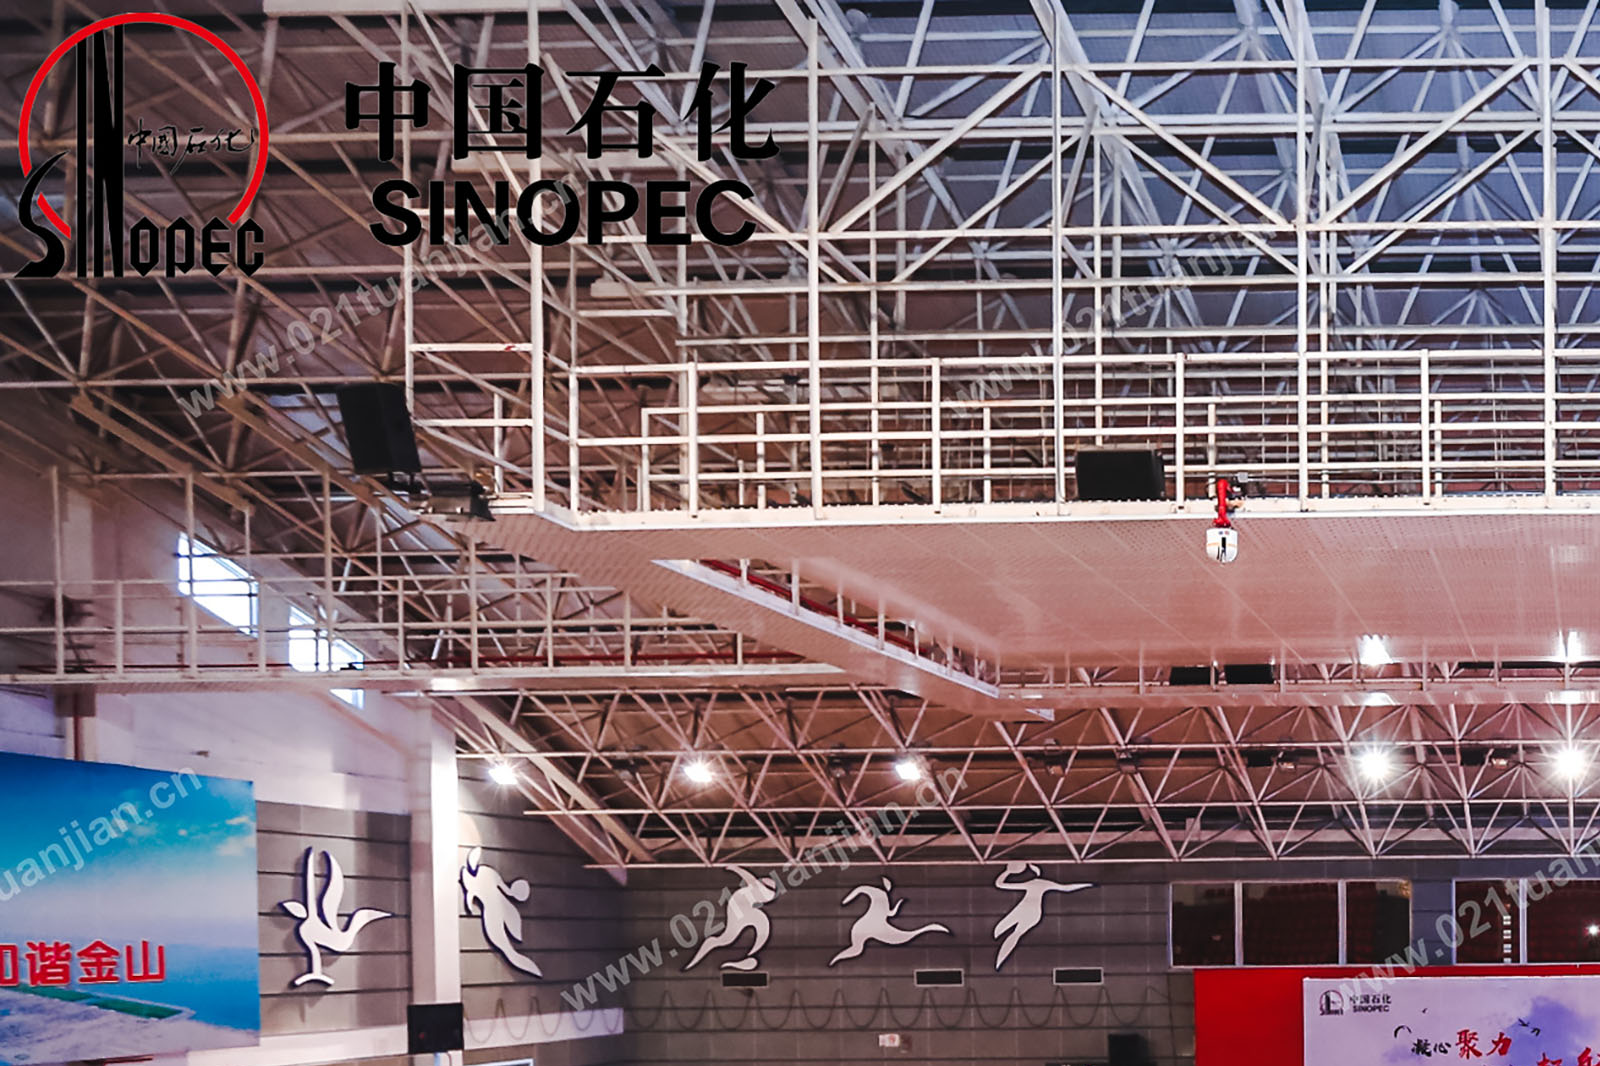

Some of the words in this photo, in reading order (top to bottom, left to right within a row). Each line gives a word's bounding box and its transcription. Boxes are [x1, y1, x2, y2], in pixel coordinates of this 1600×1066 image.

[1352, 1004, 1390, 1013] SINOPEC
[1411, 1028, 1512, 1060] 凝心聚力
